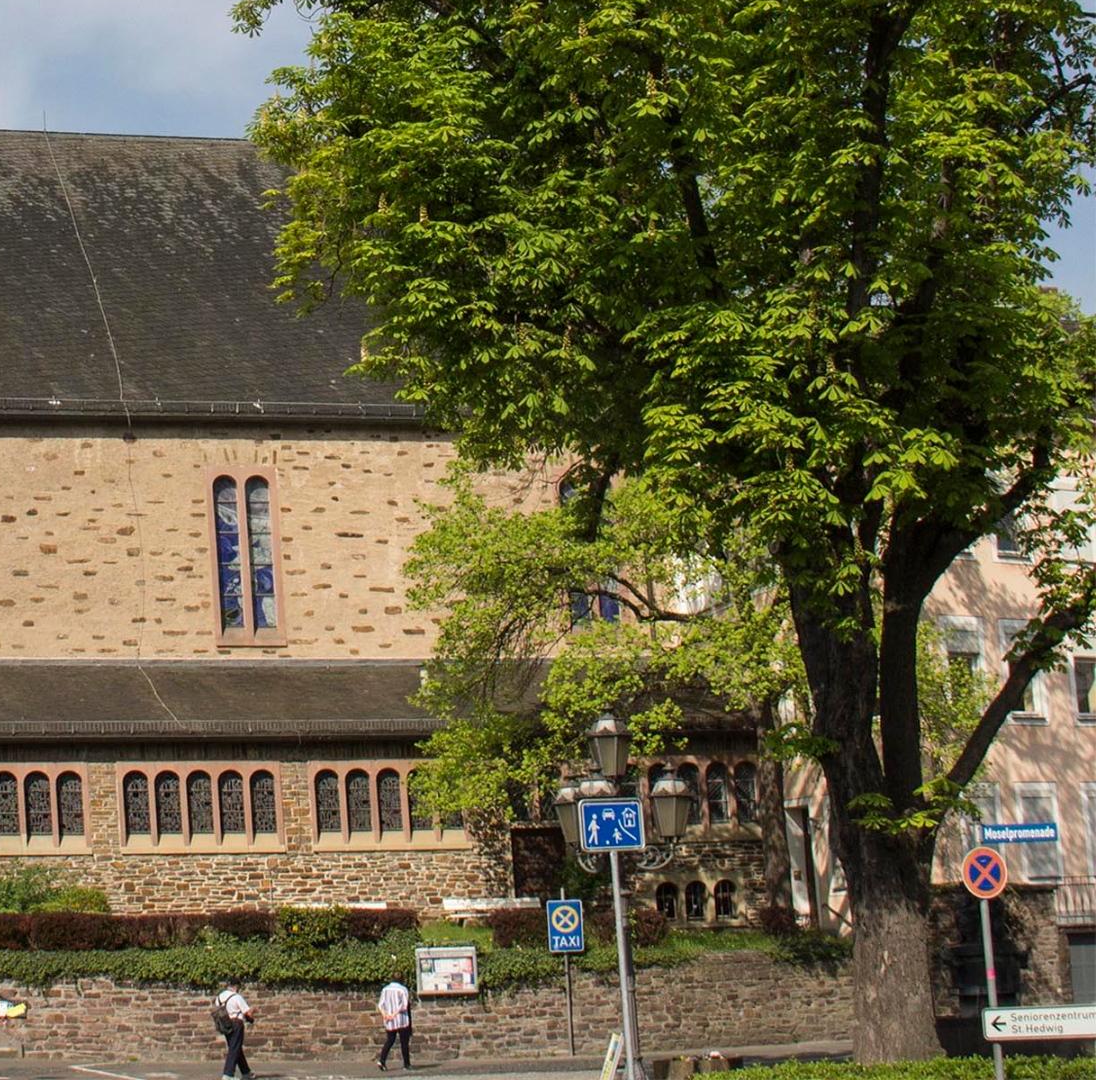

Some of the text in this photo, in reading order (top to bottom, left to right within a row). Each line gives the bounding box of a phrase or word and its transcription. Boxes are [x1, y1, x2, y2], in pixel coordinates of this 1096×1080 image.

[984, 826, 1055, 841] Moselpromenade
[552, 936, 580, 949] TAXI
[1026, 1023, 1064, 1034] Hedwig
